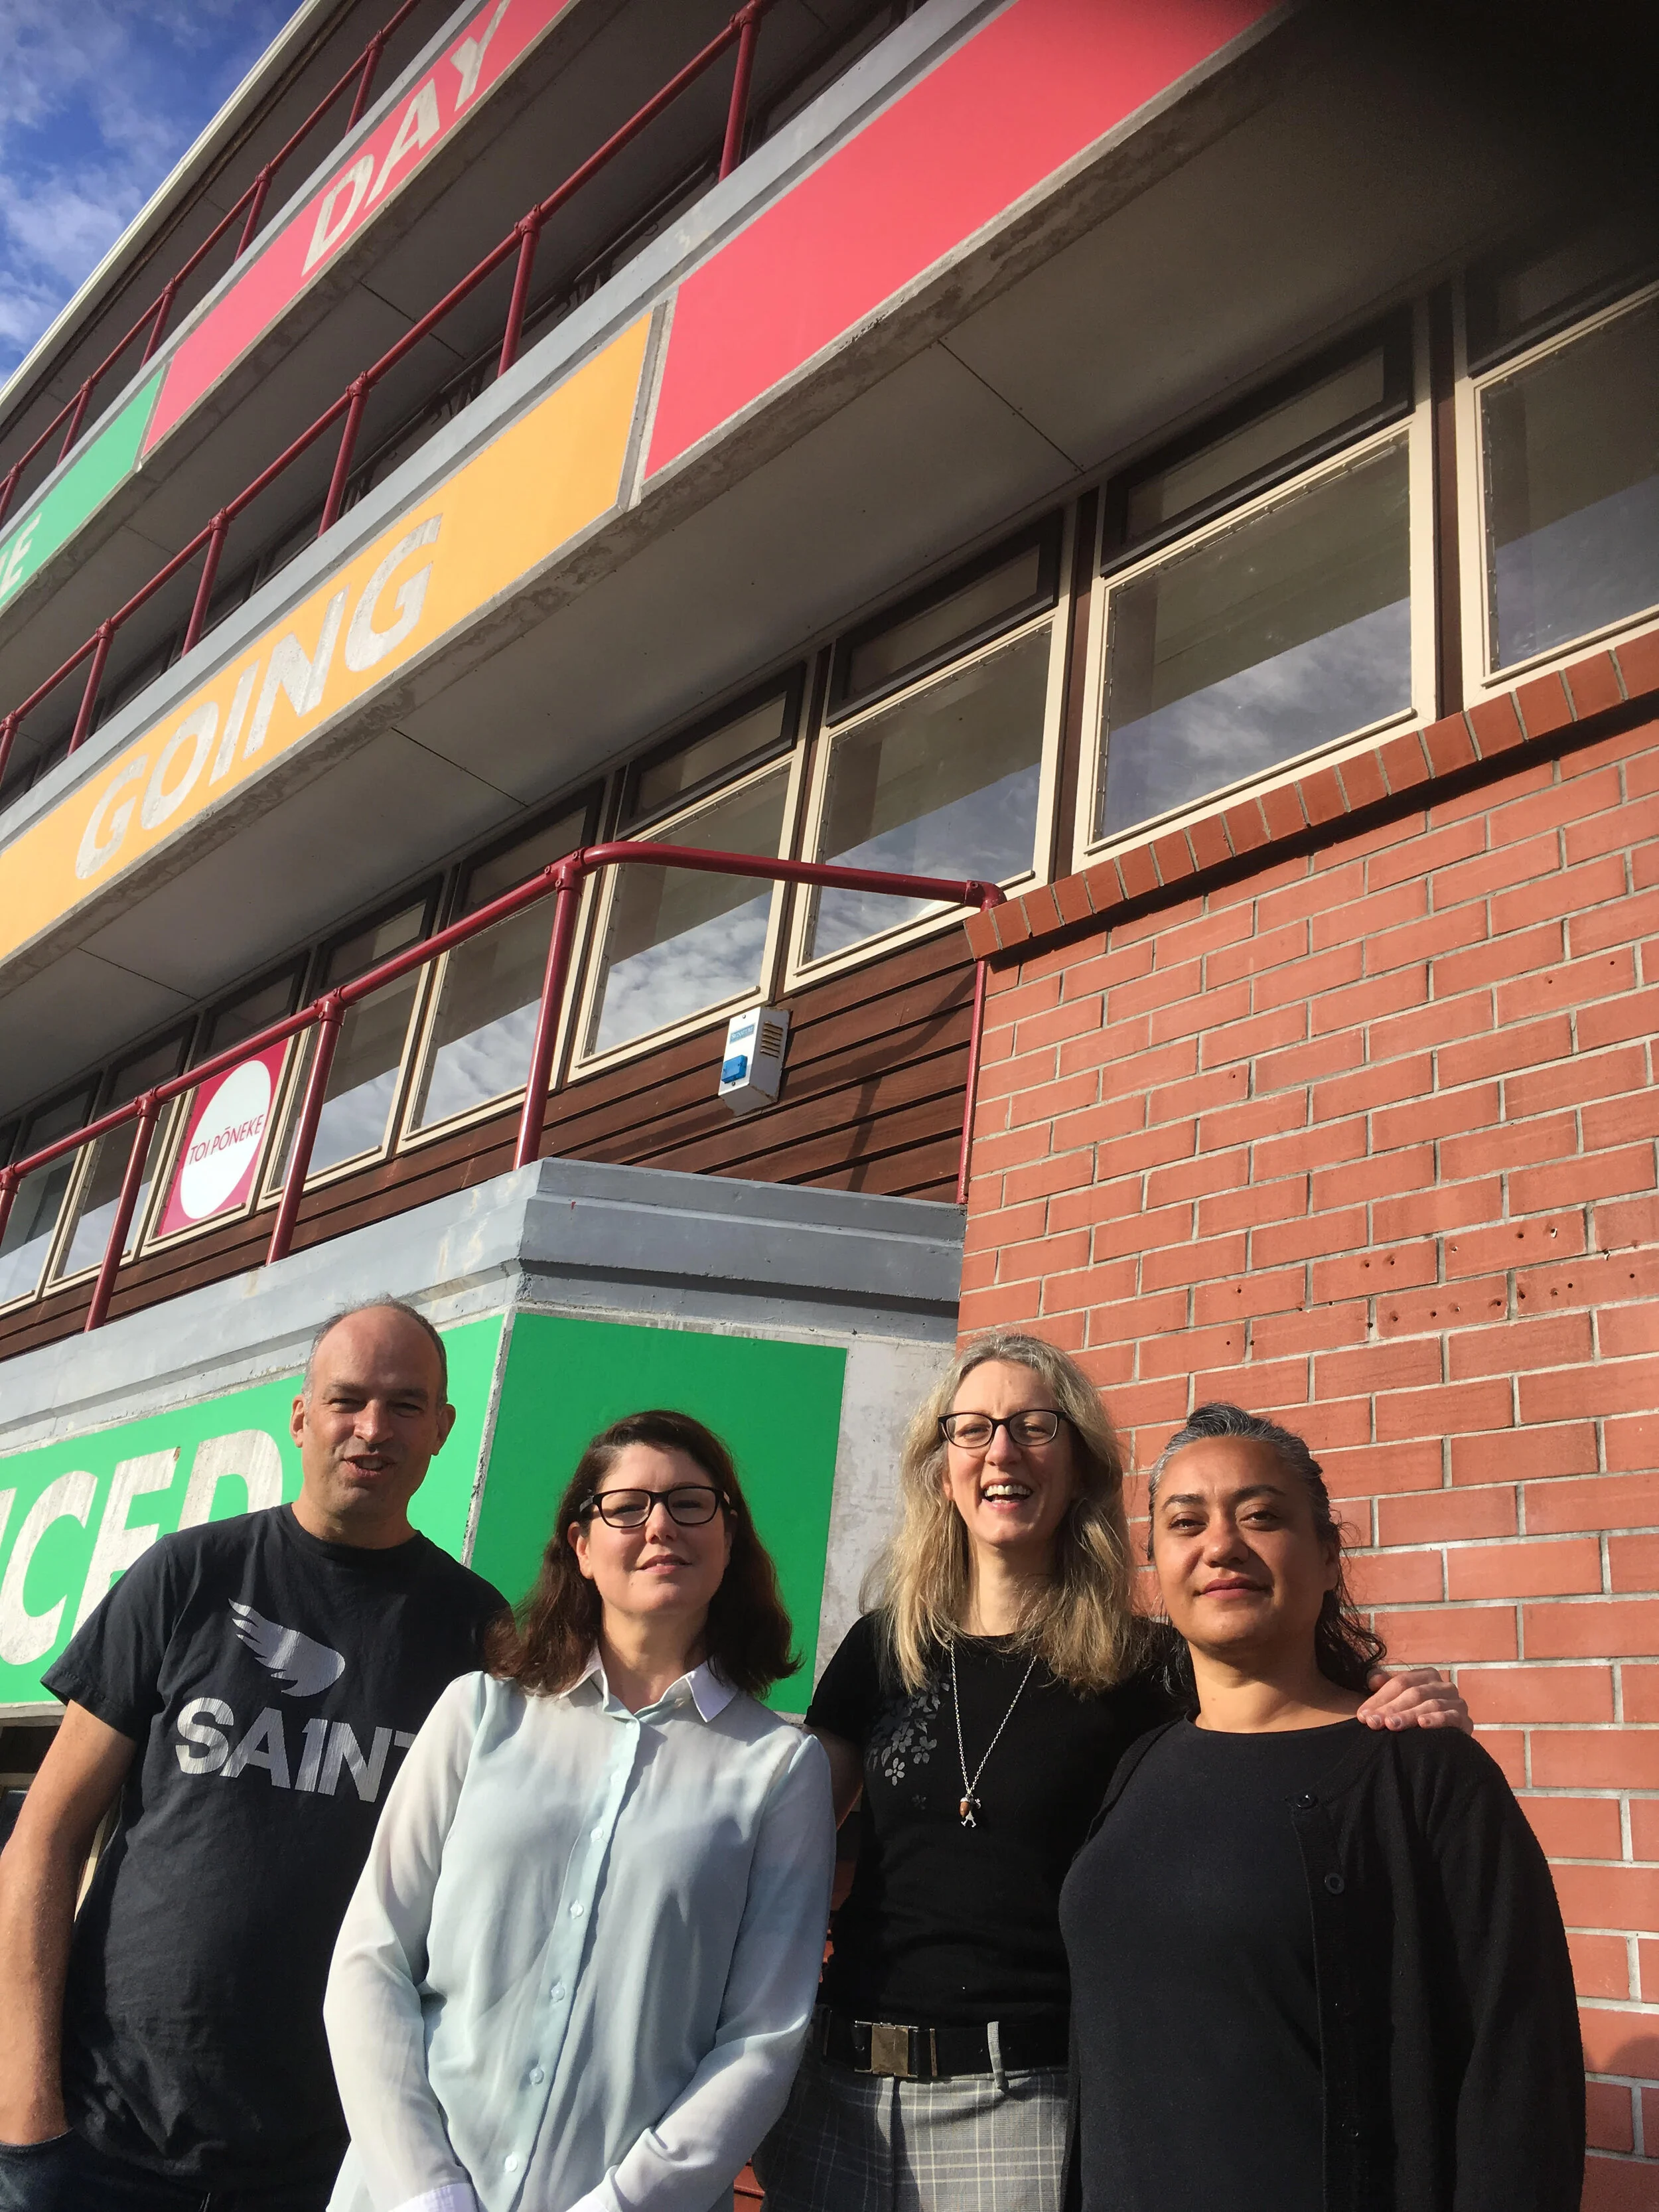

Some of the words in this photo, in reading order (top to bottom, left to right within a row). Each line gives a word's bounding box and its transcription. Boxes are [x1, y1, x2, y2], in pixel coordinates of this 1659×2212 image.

[301, 0, 511, 277] DAY
[0, 512, 42, 595] E
[75, 512, 443, 879] GOING
[190, 1141, 209, 1165] TOI
[210, 1115, 263, 1155] PŌNEKE
[0, 1429, 283, 1664] CE
